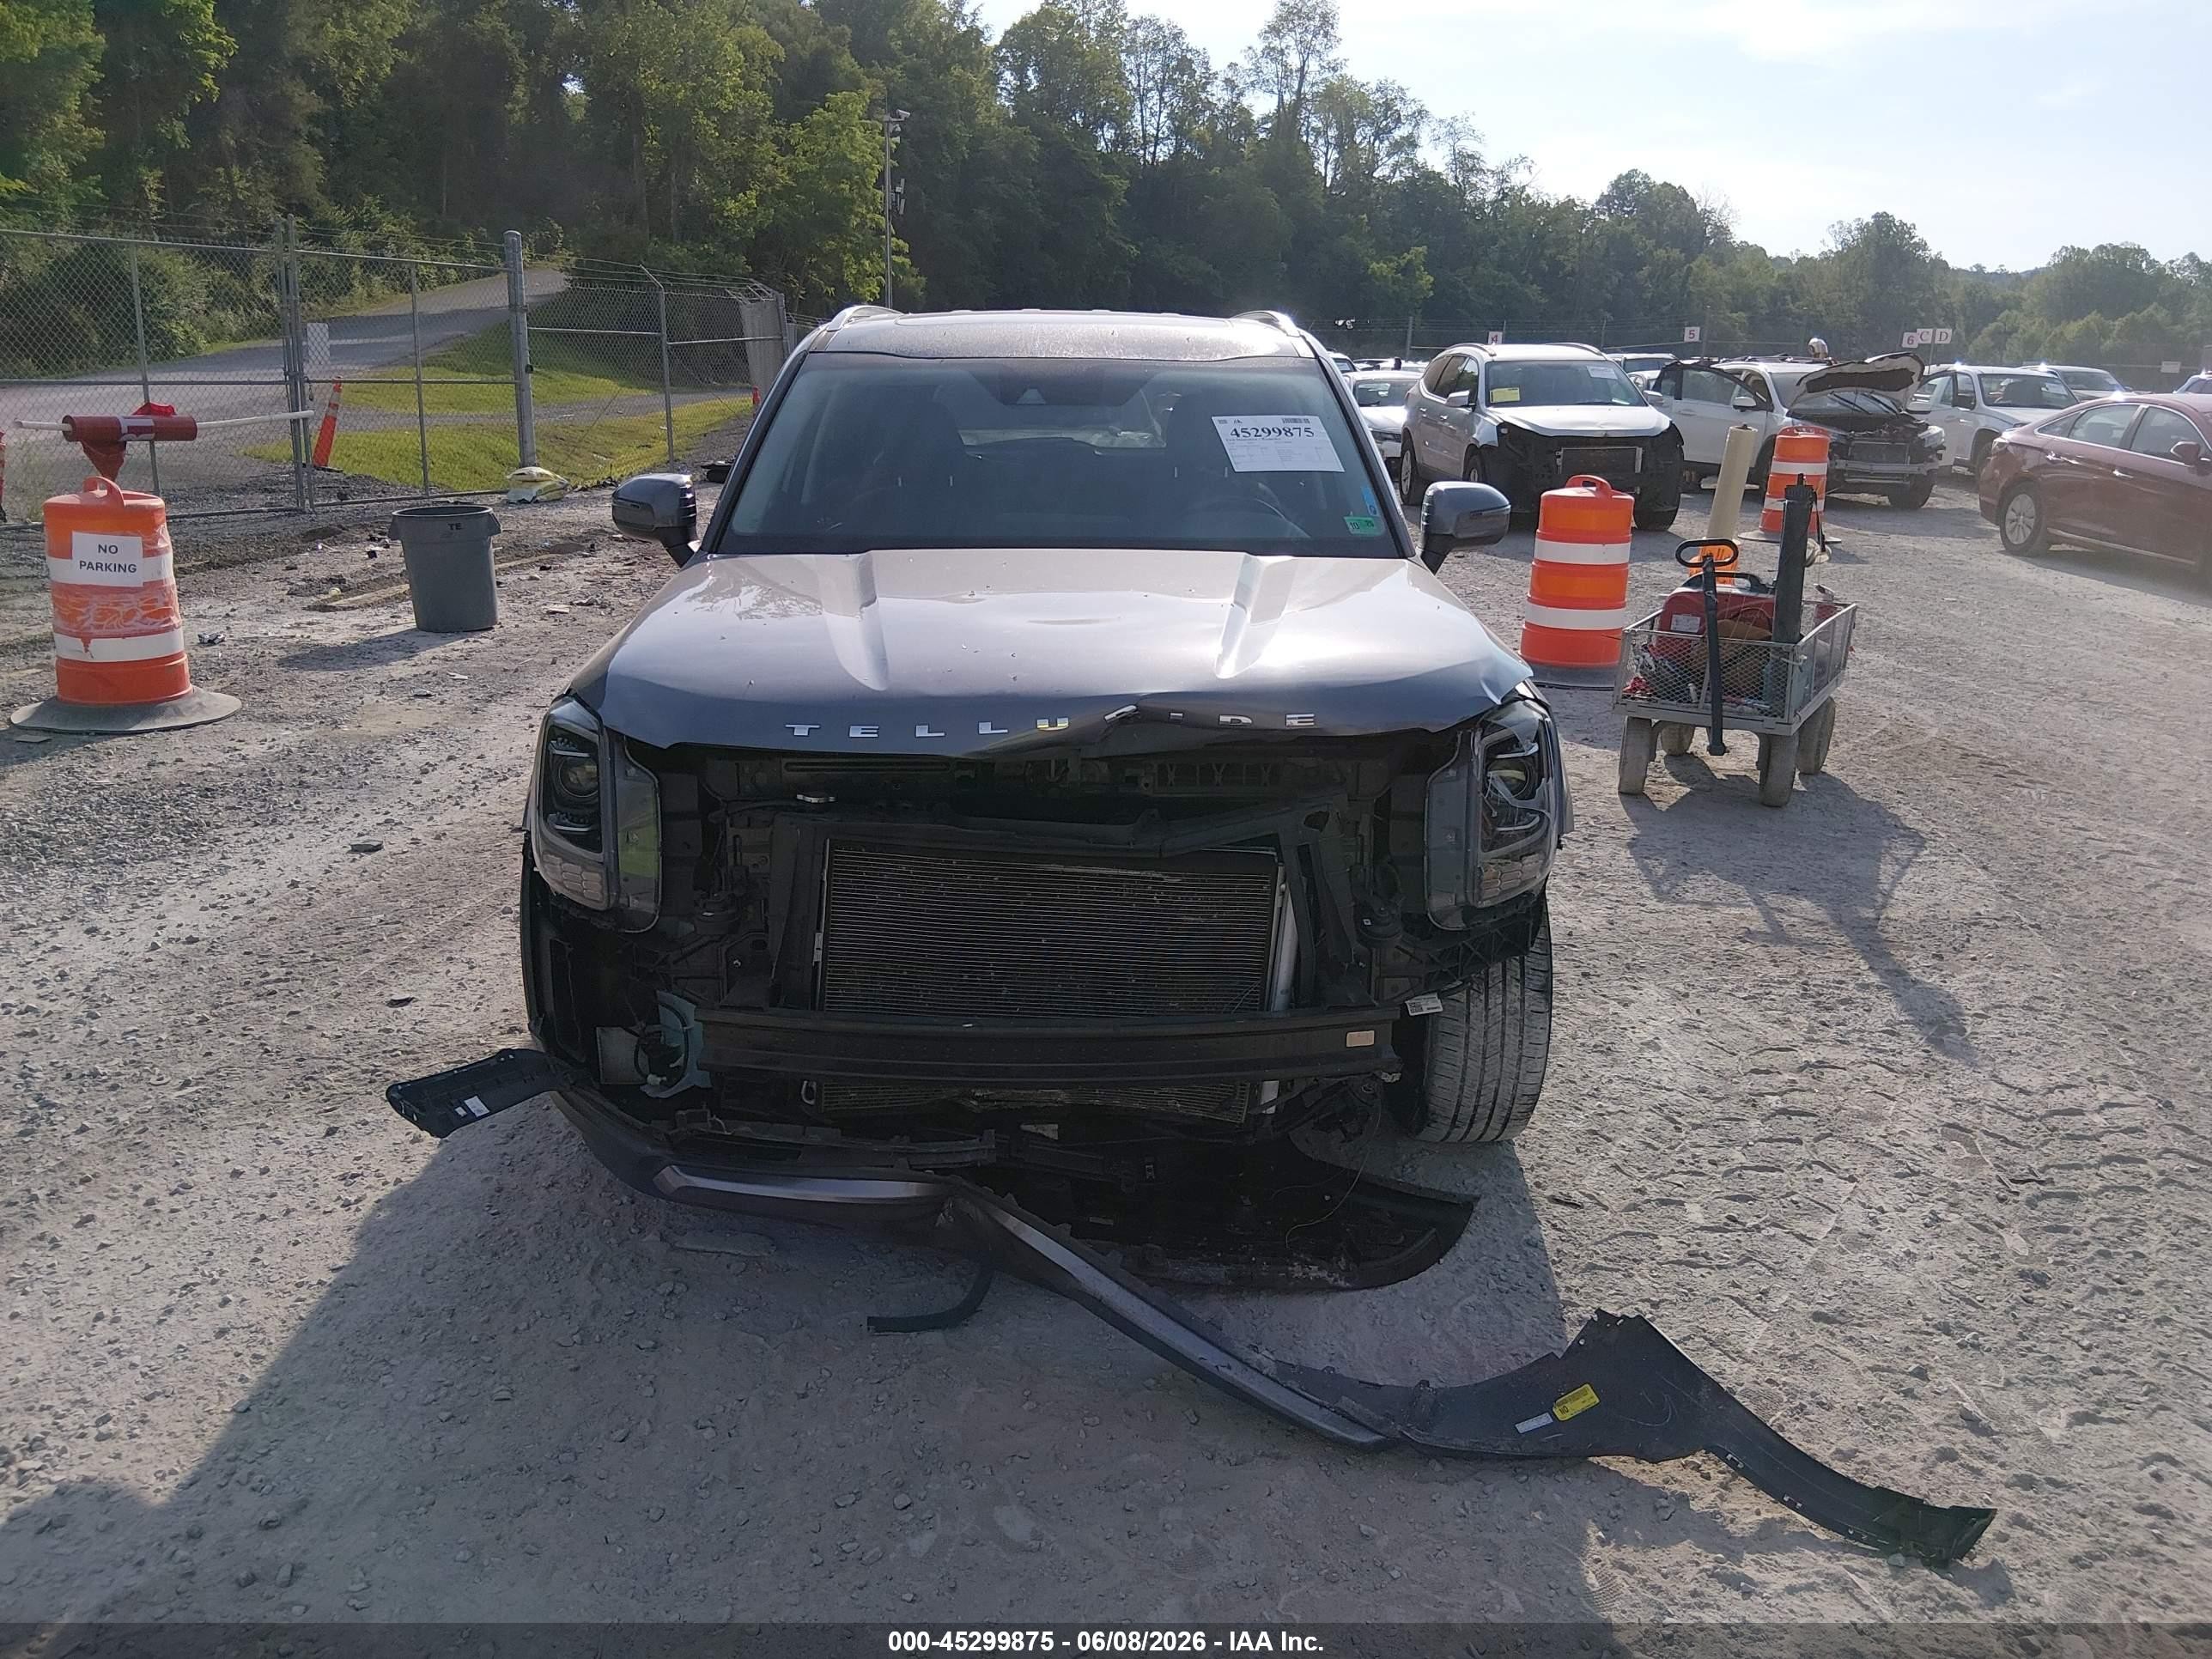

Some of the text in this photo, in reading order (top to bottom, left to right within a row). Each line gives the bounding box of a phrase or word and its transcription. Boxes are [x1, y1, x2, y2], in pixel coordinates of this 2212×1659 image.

[1688, 329, 1696, 339] 5
[1919, 331, 1930, 341] C
[1937, 331, 1949, 342] D
[1907, 335, 1915, 345] 6
[1230, 427, 1315, 438] 45299875
[97, 544, 118, 555] NO
[79, 560, 137, 574] PARKING
